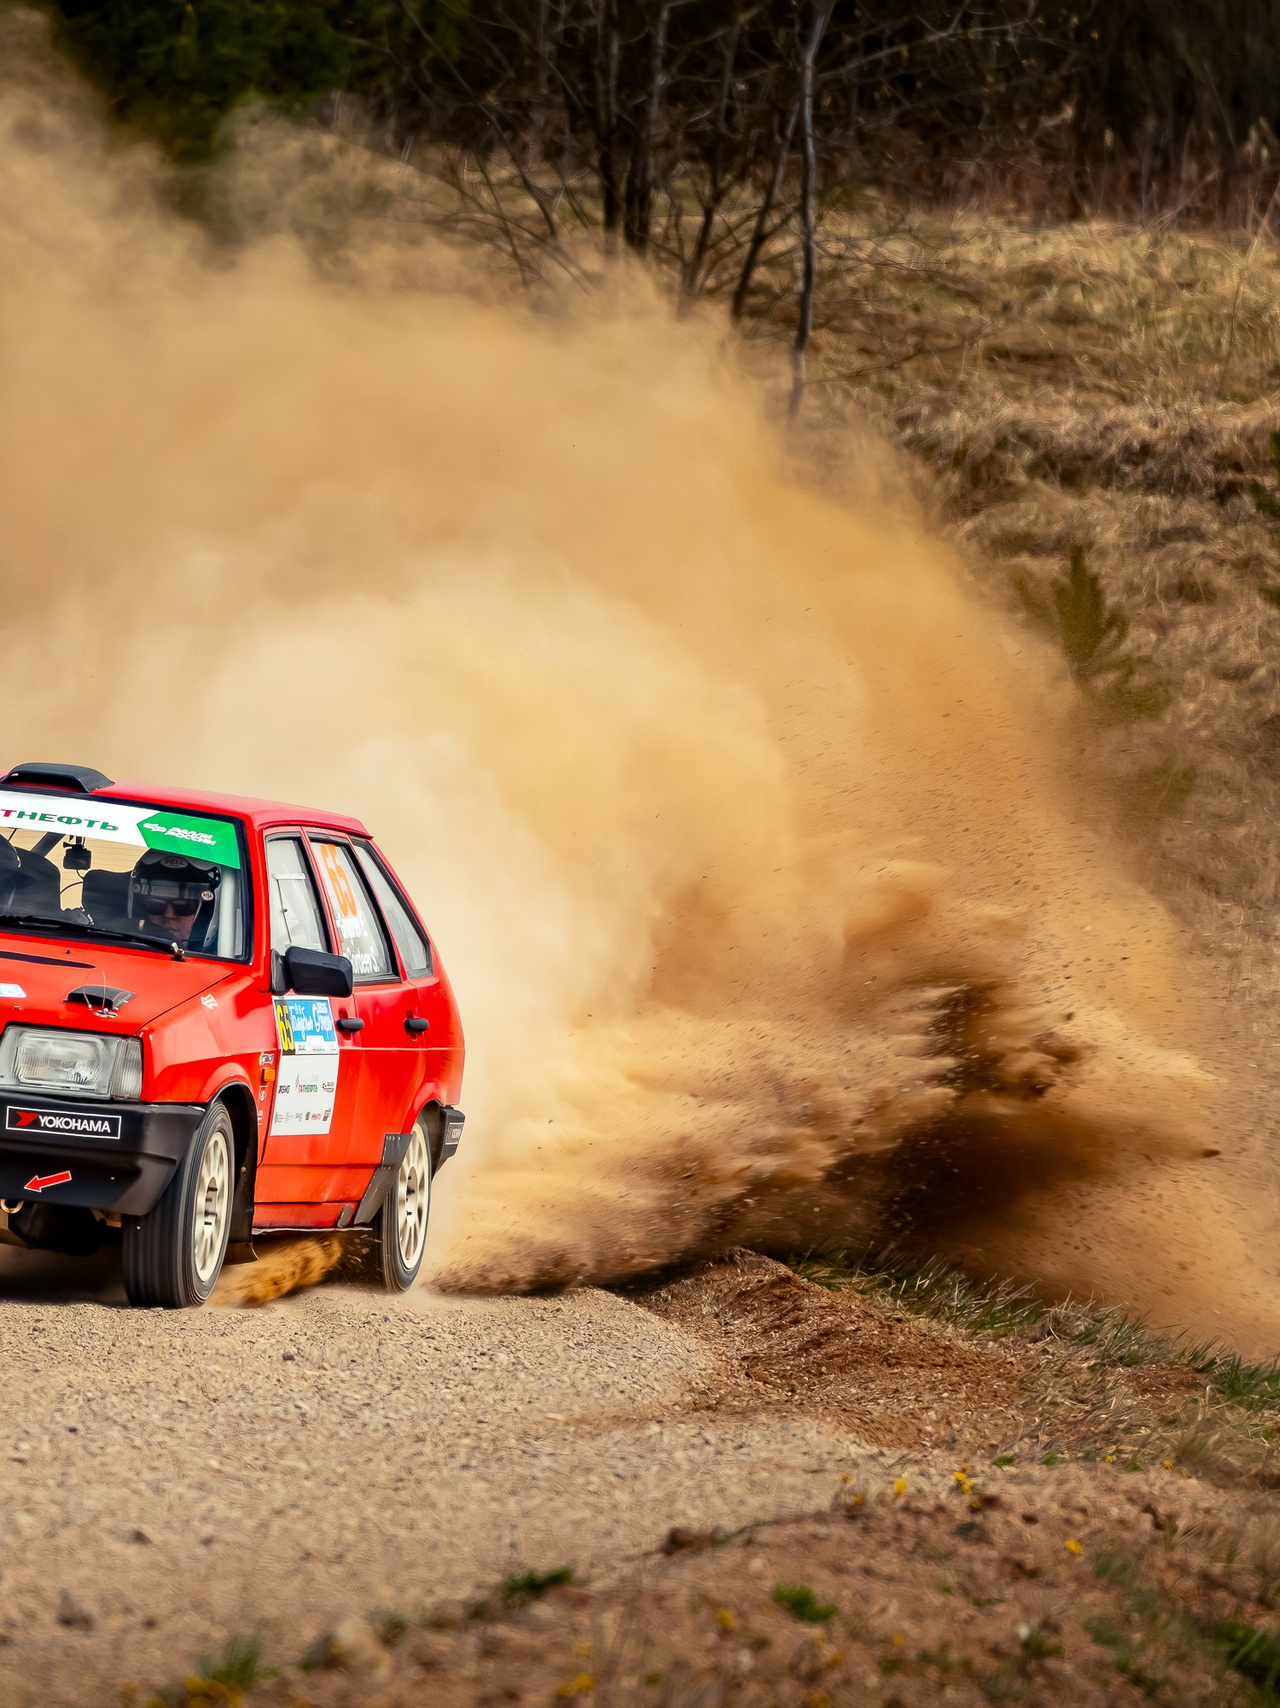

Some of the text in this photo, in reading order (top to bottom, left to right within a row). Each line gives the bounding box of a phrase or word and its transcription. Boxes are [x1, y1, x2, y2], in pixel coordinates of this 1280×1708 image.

[320, 844, 357, 918] 65
[276, 1004, 295, 1051] 65
[38, 1115, 111, 1133] YOKOHAMA
